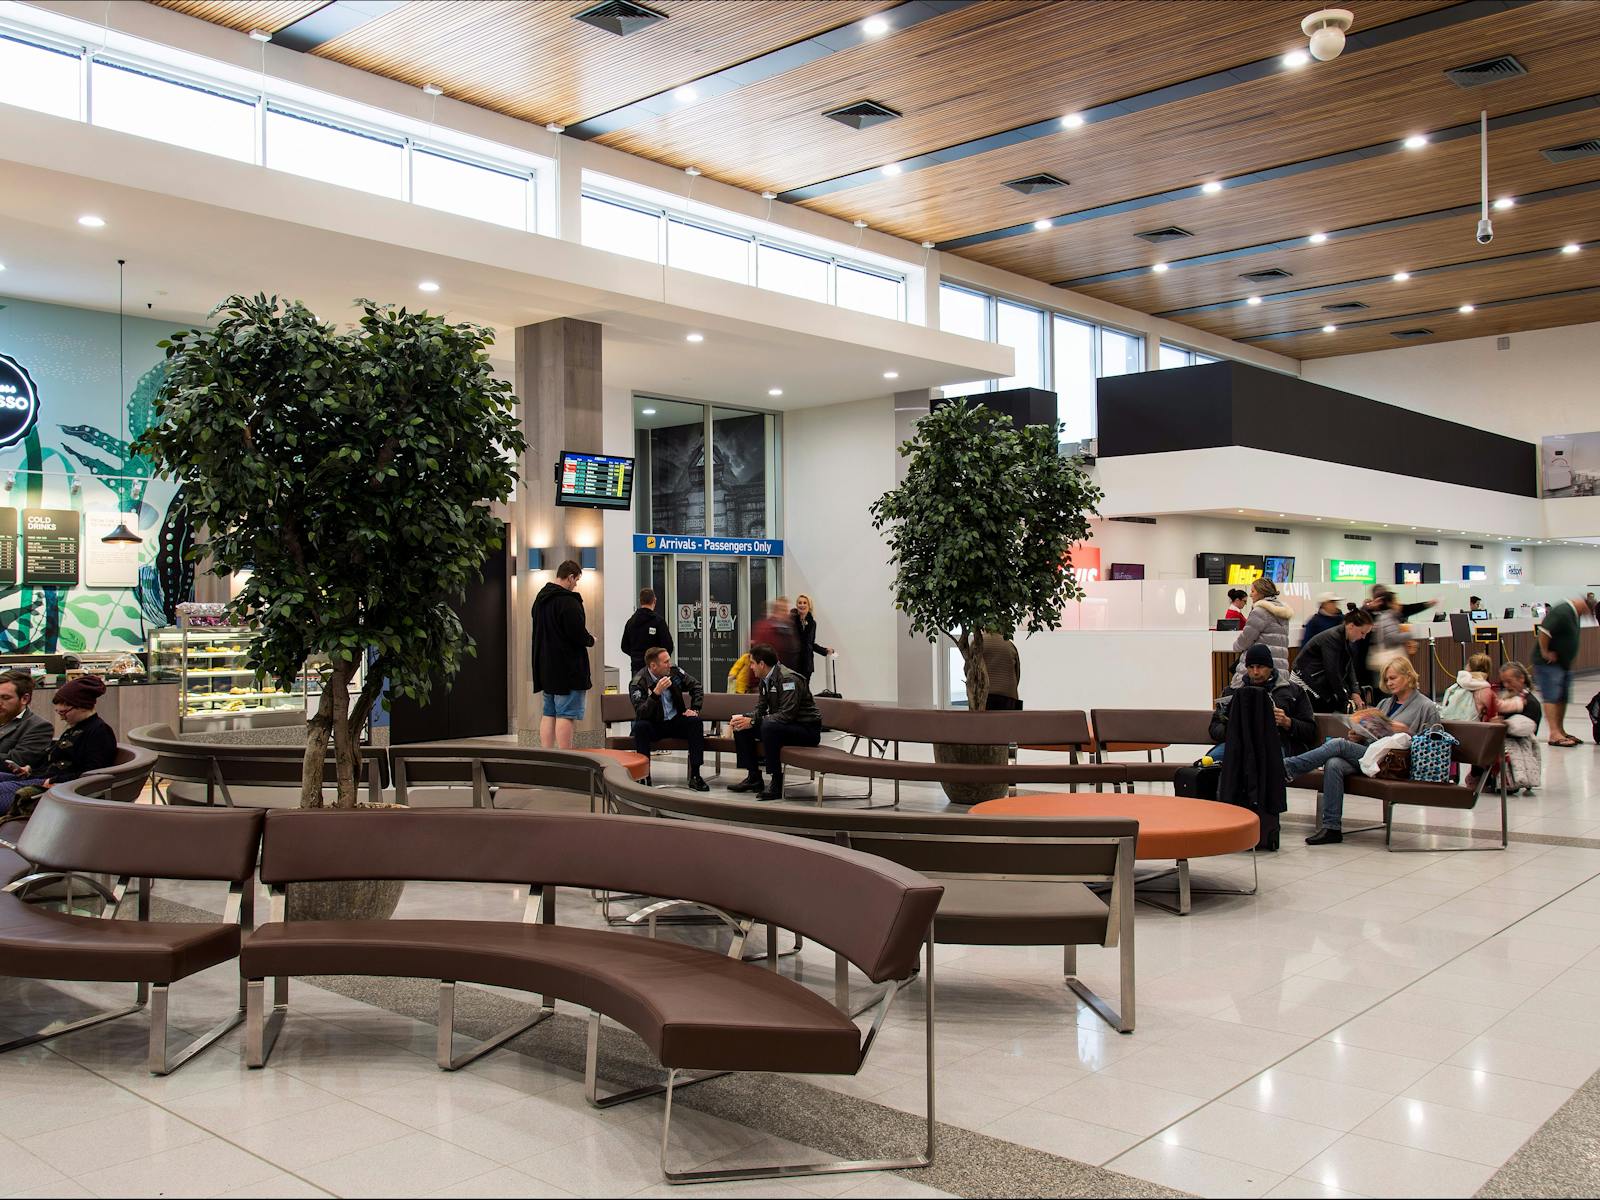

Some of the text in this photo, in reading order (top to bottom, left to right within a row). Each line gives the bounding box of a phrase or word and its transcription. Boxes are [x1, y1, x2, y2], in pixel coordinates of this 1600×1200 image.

[28, 516, 51, 524] COLD
[28, 523, 57, 531] DRINKS
[659, 537, 697, 550] Arrivals
[704, 539, 752, 553] Passengers
[754, 541, 772, 554] Only
[1227, 564, 1264, 585] Hertz
